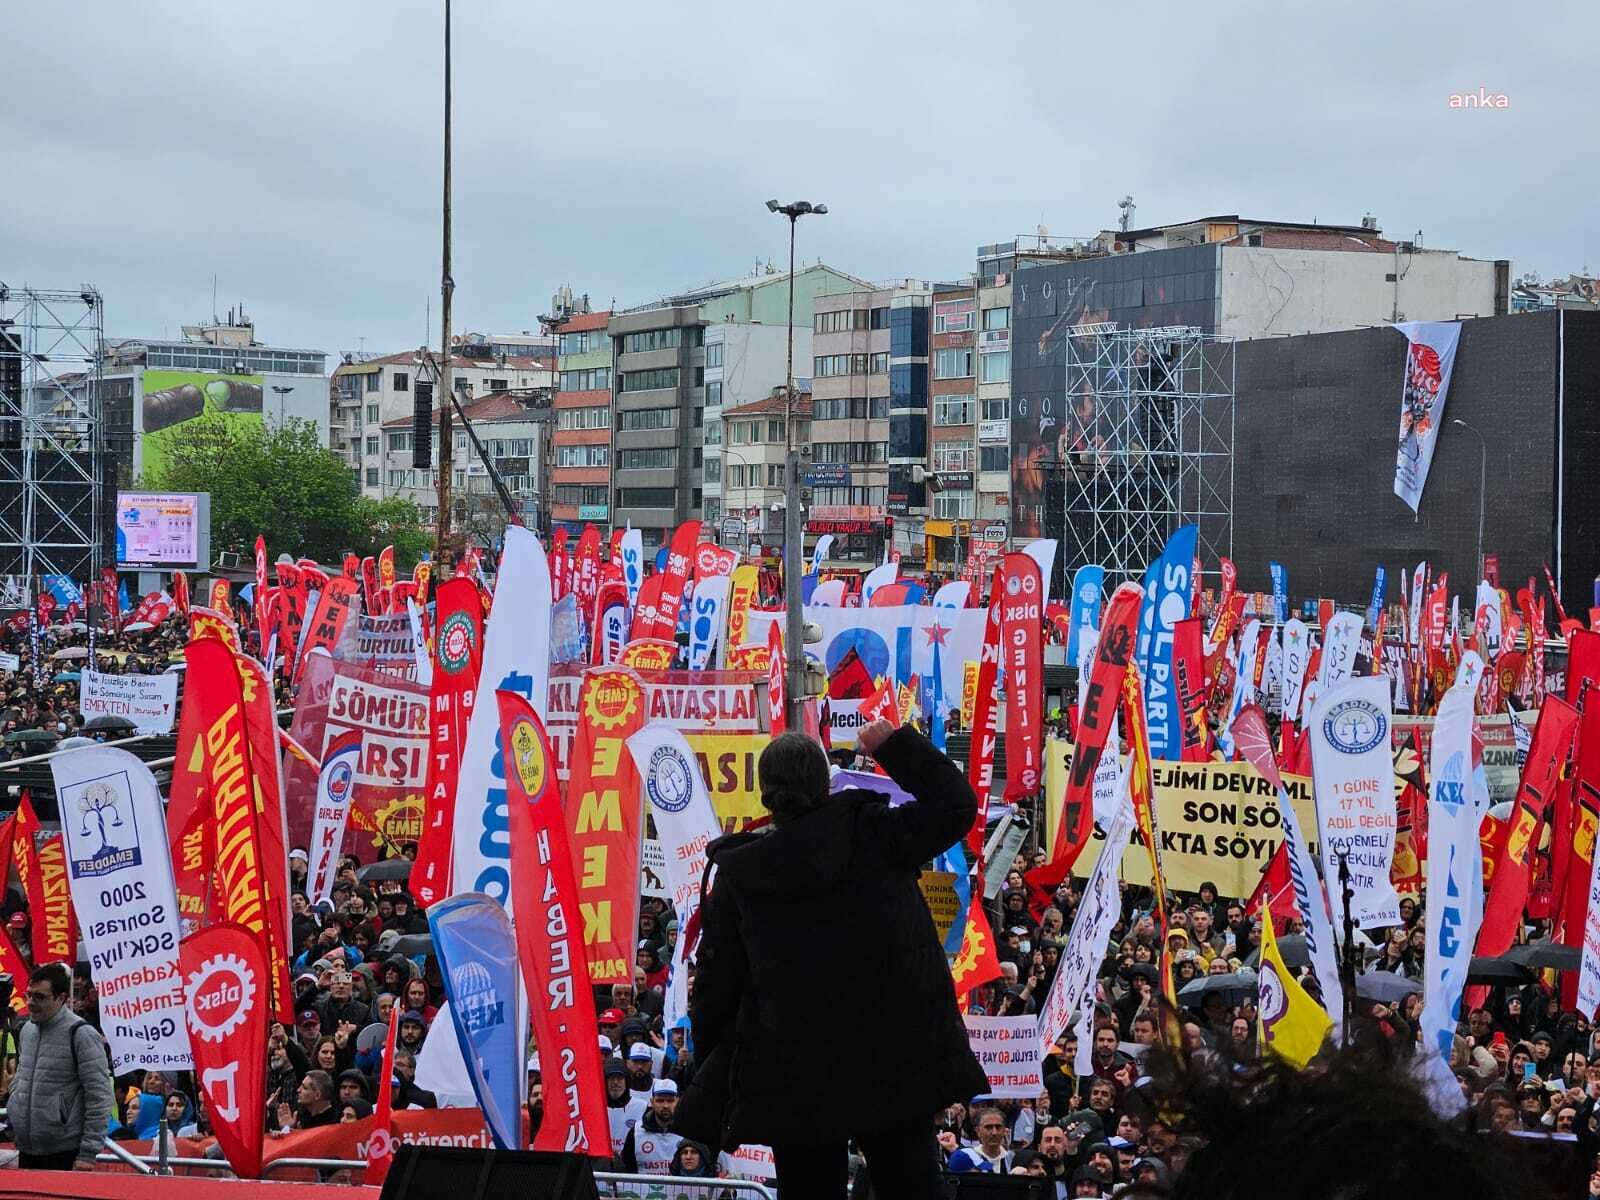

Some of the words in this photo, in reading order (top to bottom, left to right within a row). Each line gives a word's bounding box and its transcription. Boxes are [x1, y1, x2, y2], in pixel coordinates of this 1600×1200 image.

[1154, 562, 1187, 657] SOL
[696, 596, 716, 660] SOL
[84, 698, 130, 715] EMEKTEN
[1146, 662, 1171, 750] PARTİ
[1152, 765, 1208, 791] EJİMİ
[1333, 783, 1339, 794] 1
[1344, 779, 1380, 794] GÜNE
[1183, 800, 1237, 826] SON
[1243, 801, 1282, 829] SÖ
[1340, 799, 1353, 811] 17
[1356, 796, 1375, 809] YIL
[1327, 816, 1355, 829] ADİL
[1360, 814, 1397, 828] DEĞİL
[1092, 821, 1208, 856] SKKTA
[1327, 832, 1389, 848] KADEMELİ
